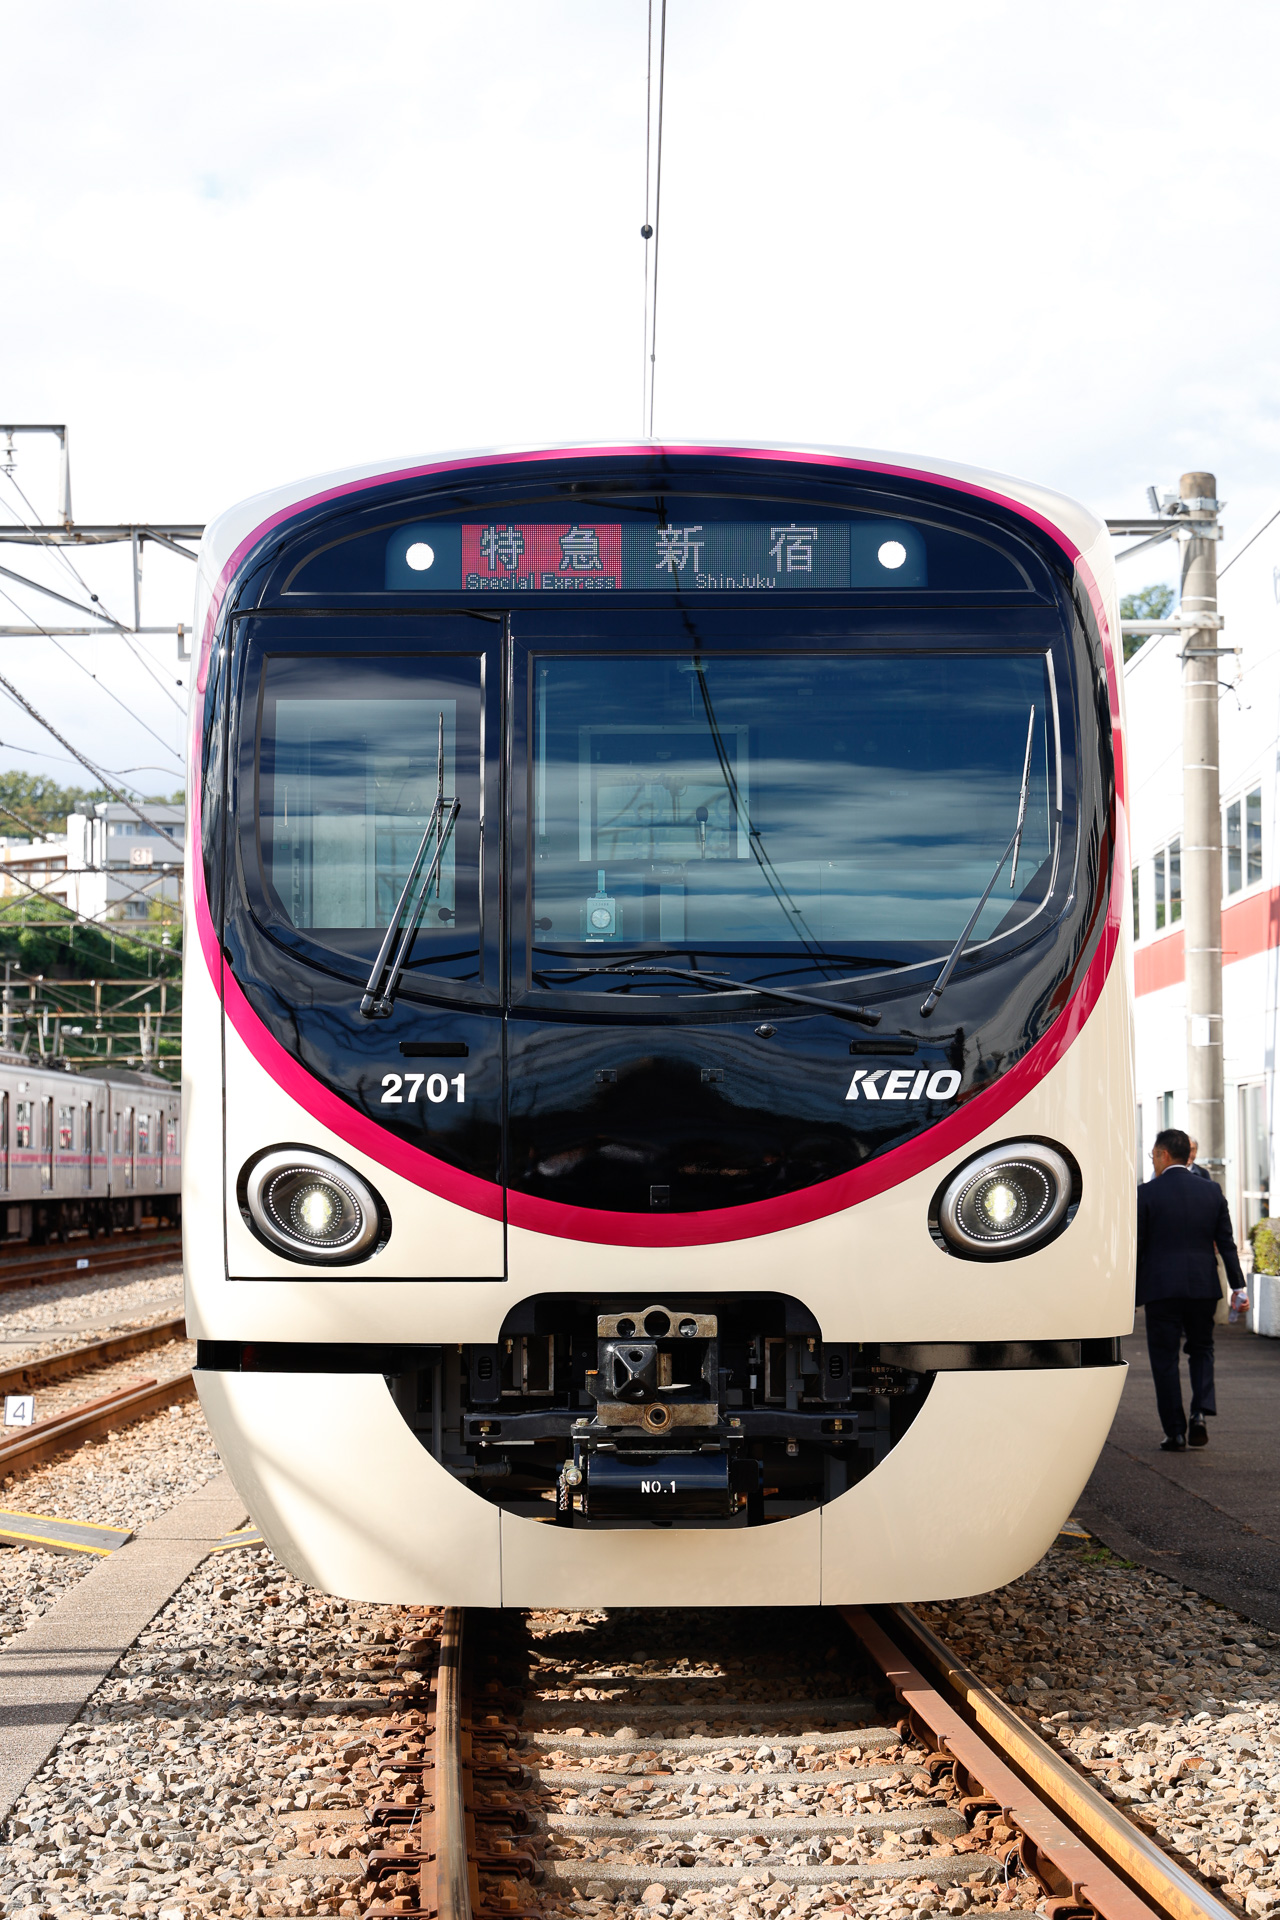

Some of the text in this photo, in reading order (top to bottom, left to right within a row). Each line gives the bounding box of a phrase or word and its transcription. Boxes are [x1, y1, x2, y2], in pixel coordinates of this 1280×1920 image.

[481, 526, 603, 570] 特急
[655, 523, 818, 572] 新宿
[467, 573, 615, 589] Special Express
[696, 573, 776, 589] Shinjuku
[380, 1073, 465, 1103] 2701
[845, 1069, 962, 1100] KEIO
[13, 1401, 26, 1421] 4
[641, 1480, 676, 1494] NO.1
